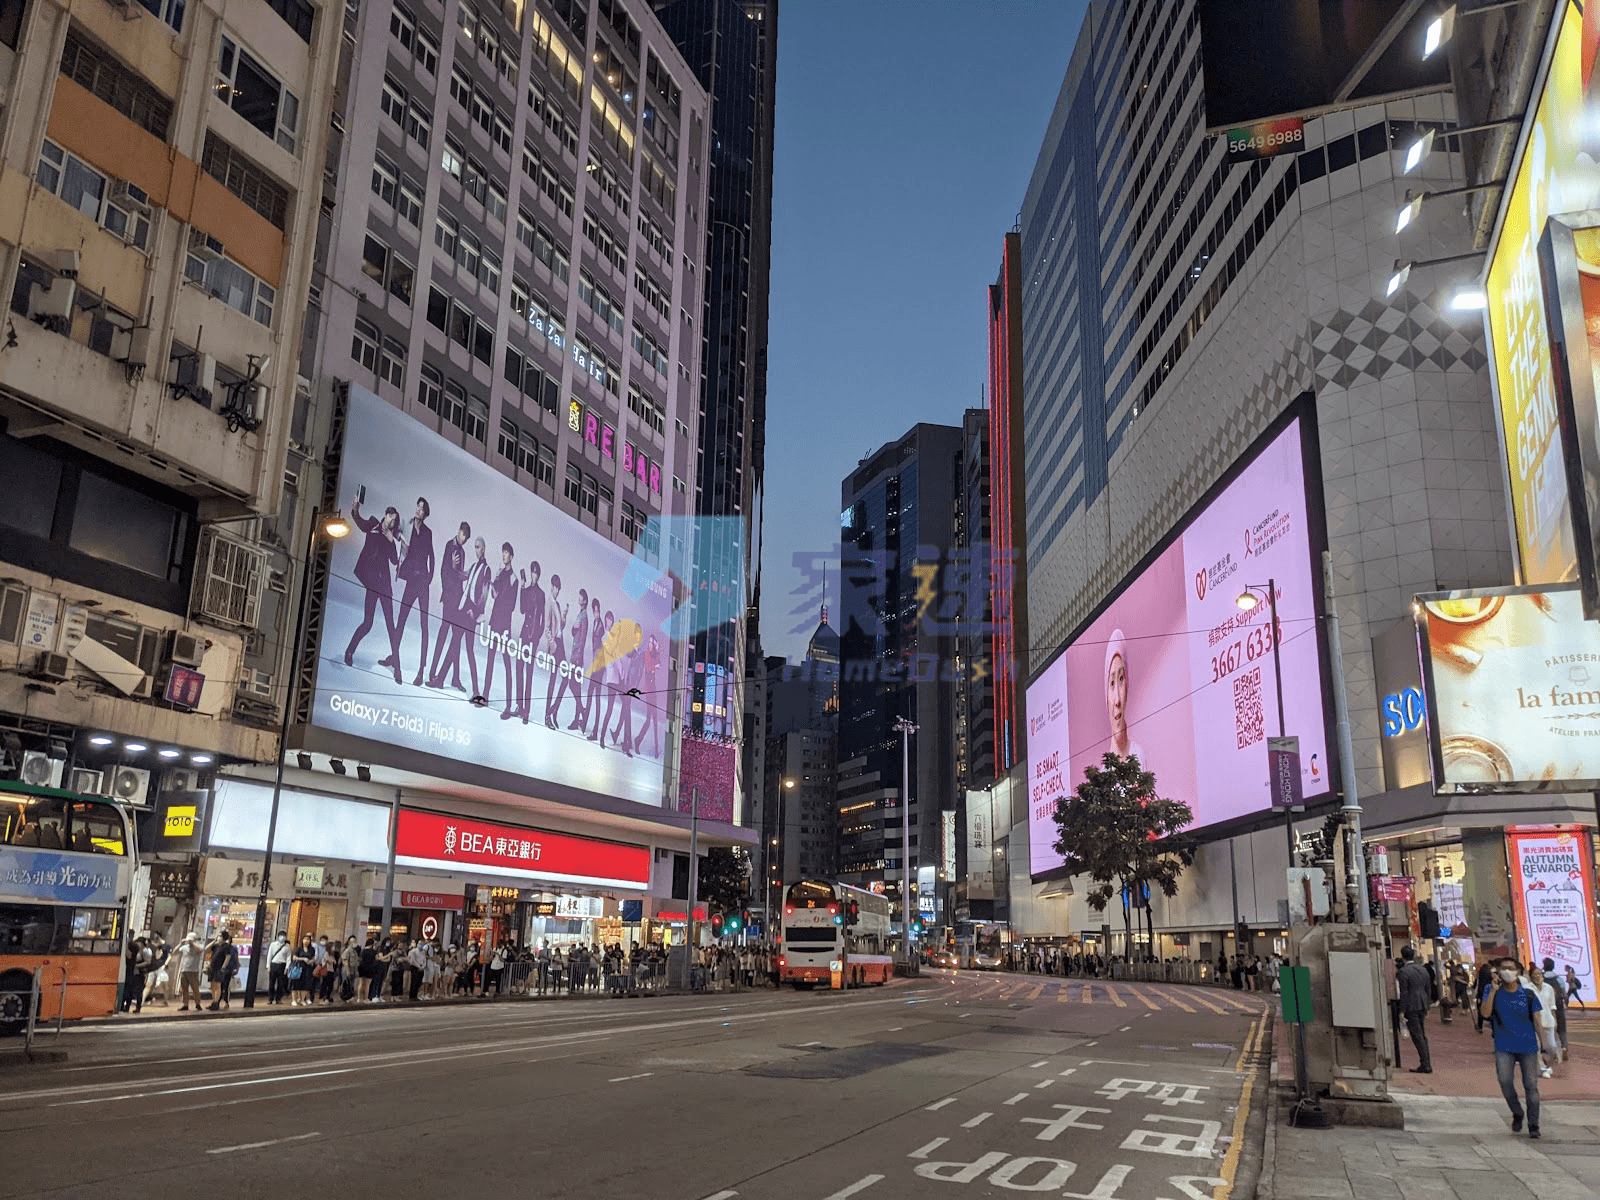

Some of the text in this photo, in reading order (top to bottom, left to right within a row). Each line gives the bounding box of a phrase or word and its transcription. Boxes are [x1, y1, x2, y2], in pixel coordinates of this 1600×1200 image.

[1229, 129, 1303, 153] 5649 6988
[572, 343, 602, 381] Hair
[622, 442, 660, 494] BAR
[1264, 587, 1282, 609] Nw
[479, 622, 585, 684] Unfold an era
[1211, 640, 1242, 683] 3667
[1516, 687, 1543, 709] la
[330, 694, 472, 746] Galaxy Z Fold3 Flip3 5G
[1548, 726, 1581, 737] ATELIER
[1284, 778, 1293, 803] KONG
[460, 831, 542, 861] BEA 東亞銀行
[1524, 854, 1575, 864] AUTUMN
[1522, 863, 1579, 874] REWARDS
[1020, 1103, 1223, 1160] 巴士
